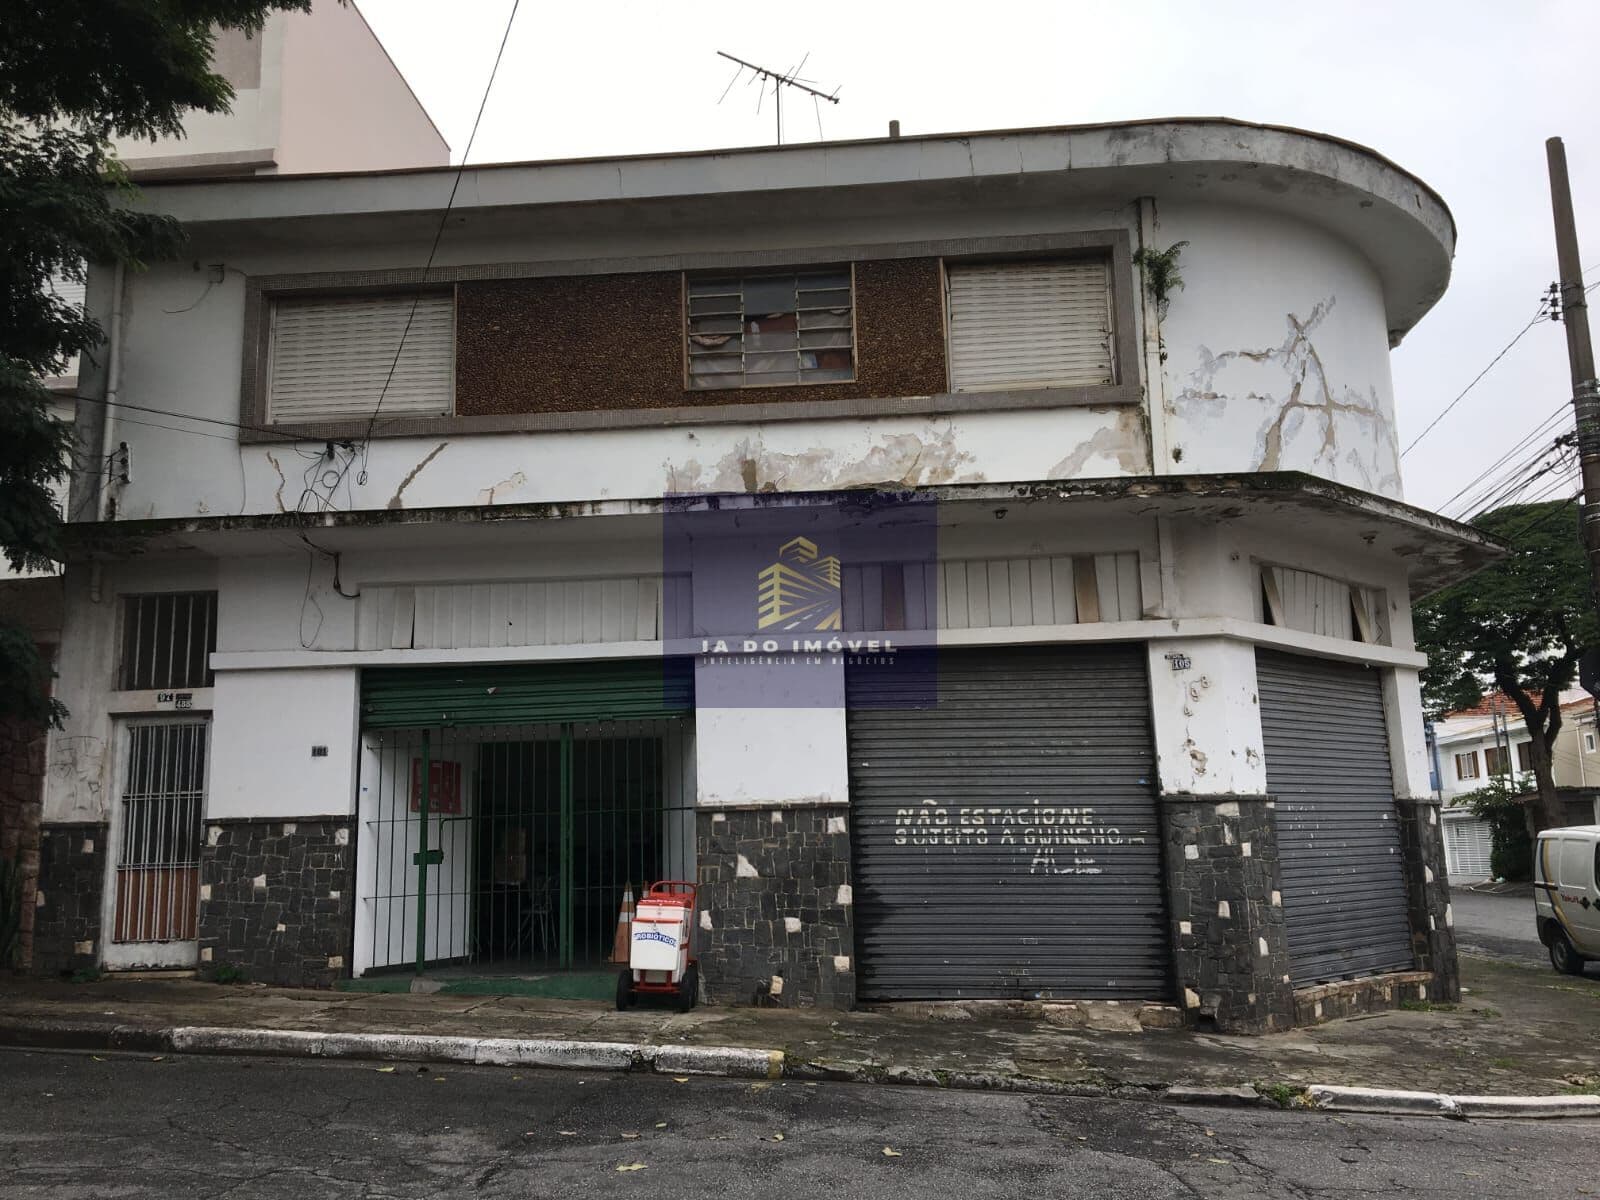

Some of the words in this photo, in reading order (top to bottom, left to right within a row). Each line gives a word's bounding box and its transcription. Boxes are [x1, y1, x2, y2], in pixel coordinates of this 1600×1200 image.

[895, 799, 949, 825] NÃO
[959, 799, 1096, 825] ESTACIONE
[1000, 828, 1016, 845] A
